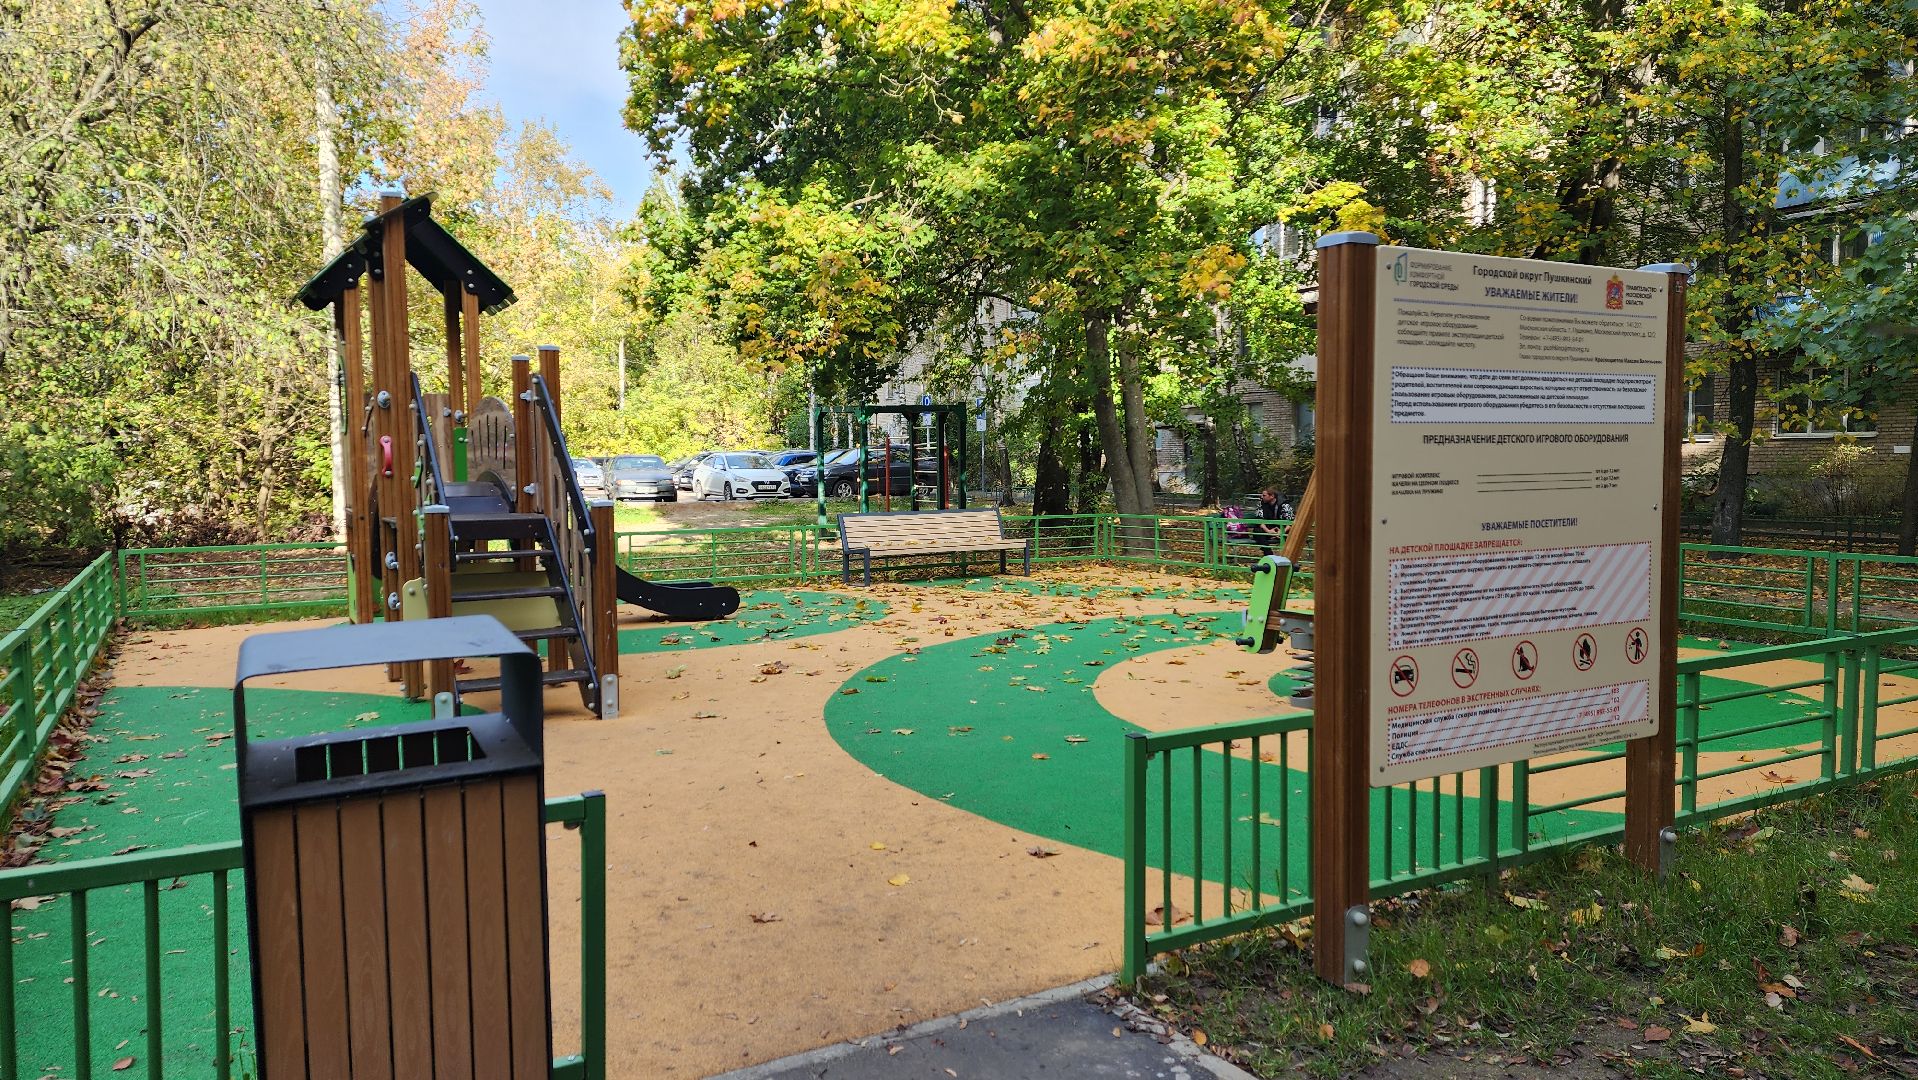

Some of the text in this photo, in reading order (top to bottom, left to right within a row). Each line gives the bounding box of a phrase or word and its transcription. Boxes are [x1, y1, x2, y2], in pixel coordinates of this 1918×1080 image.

[1473, 265, 1591, 286] Городской округ Пушкинский
[1409, 280, 1458, 291] ГОРОДСКОЙ СРЕДЫ
[1484, 286, 1577, 303] УВАЖАЕМЫЕ ЖИТЕЛИ!
[1423, 433, 1629, 445] ПРЕДНАЗНАЧЕНИЕ ДЕТСКОГО ИГРОВОГО ОБОРУДОВАНИЯ
[1481, 517, 1577, 530] УВАЖАЕМЫЕ ПОСЕТИТЕЛИ!
[1389, 538, 1522, 554] НА ДЕТСКОЙ ПЛОЩАДКЕ ЗАПРЕЩАЕТСЯ:
[1388, 702, 1417, 714] НОМЕРА
[1418, 696, 1460, 710] ТЕЛЕФОНОВ
[1461, 695, 1465, 704] В
[1466, 689, 1509, 703] ЭКСТРЕННЫХ
[1391, 716, 1432, 729] Медицинская
[1433, 713, 1454, 723] служба
[1391, 728, 1418, 740] Полиция
[1391, 741, 1408, 750] ЕДДС
[1391, 749, 1414, 760] Служба
